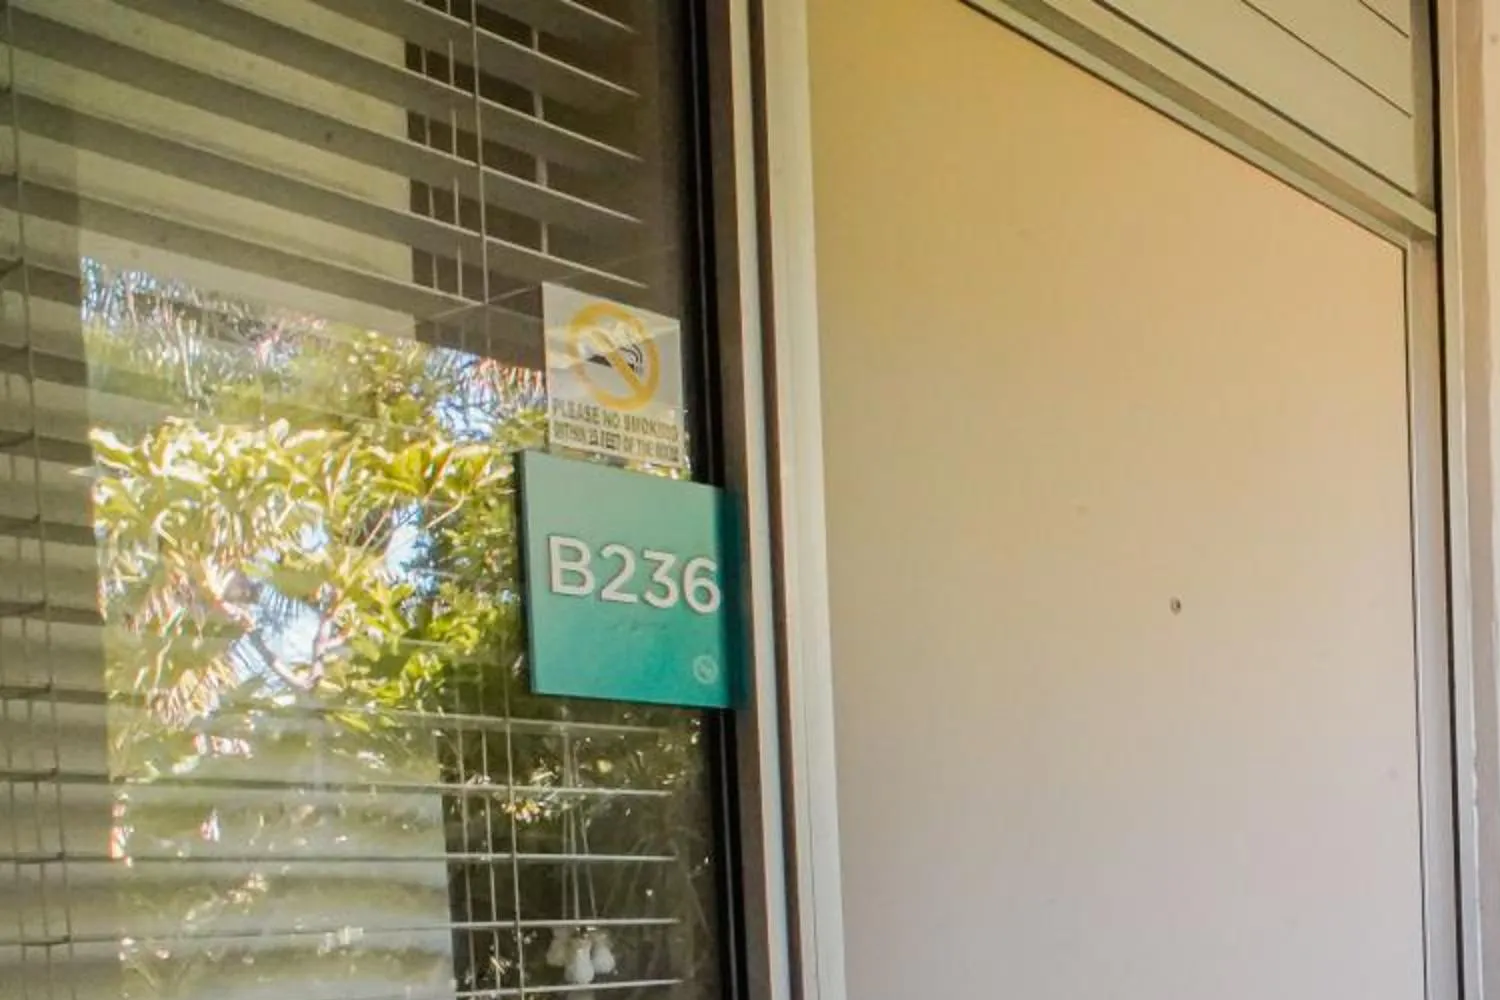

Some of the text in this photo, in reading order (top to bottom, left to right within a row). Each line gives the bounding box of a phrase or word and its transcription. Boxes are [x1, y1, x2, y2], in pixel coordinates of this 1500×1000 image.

[552, 398, 601, 424] PLEASE
[603, 410, 620, 429] NO
[548, 535, 721, 614] B236
